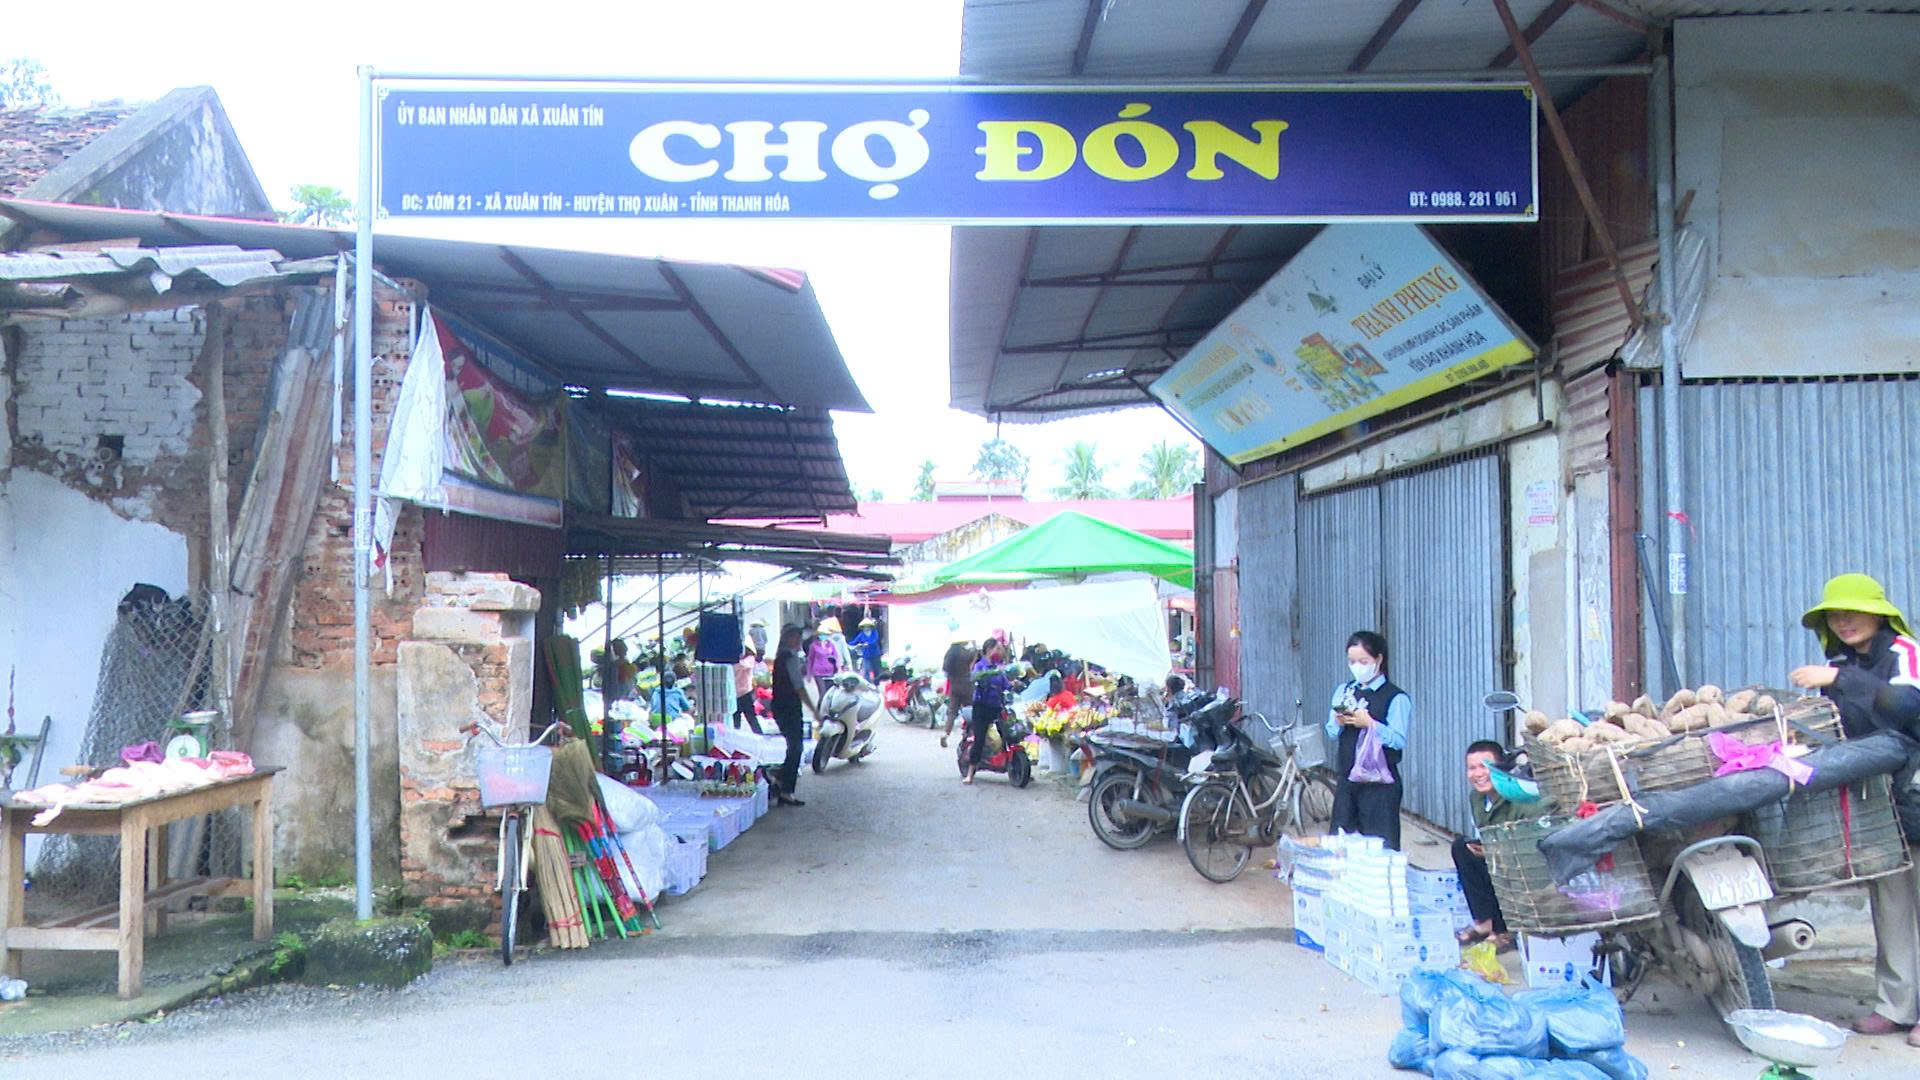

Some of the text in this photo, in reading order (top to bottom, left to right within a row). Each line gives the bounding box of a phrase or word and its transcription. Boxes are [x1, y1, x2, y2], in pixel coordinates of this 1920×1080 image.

[397, 100, 604, 127] ỦY BAN NHÂN DÂN XÃ XUÂN TÍN
[629, 103, 1289, 200] CHỢ ĐÓN
[402, 194, 423, 211] ĐC:
[426, 192, 454, 211] XÓM
[457, 195, 472, 211] 21
[484, 192, 501, 211] XÃ
[505, 192, 539, 211] XUÂN
[543, 192, 562, 211] TÍN
[573, 192, 614, 215] HUYỆN
[618, 195, 641, 215] THỌ
[644, 192, 678, 212] XUÂN
[690, 191, 718, 212] TỈNH
[721, 195, 762, 212] THANH
[765, 192, 790, 212] HÓA
[1409, 191, 1517, 206] ĐT: 0988. 281 961
